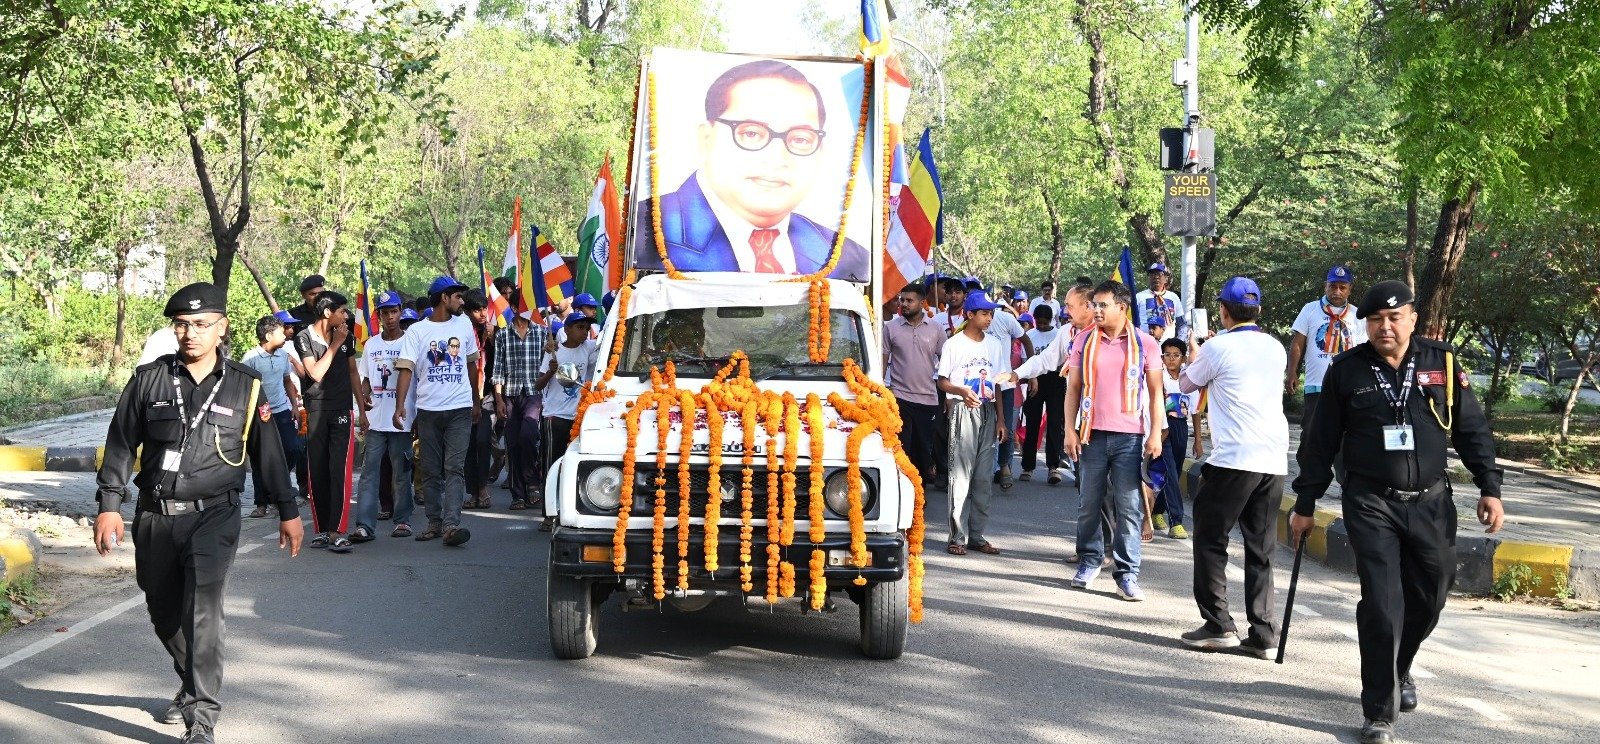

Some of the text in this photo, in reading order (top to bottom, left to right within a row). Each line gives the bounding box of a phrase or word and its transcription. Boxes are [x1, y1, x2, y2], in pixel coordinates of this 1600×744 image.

[1173, 175, 1208, 186] YOUR
[1169, 186, 1211, 196] SPEED
[370, 349, 401, 358] जय भार
[454, 361, 464, 373] के
[386, 391, 397, 399] भी
